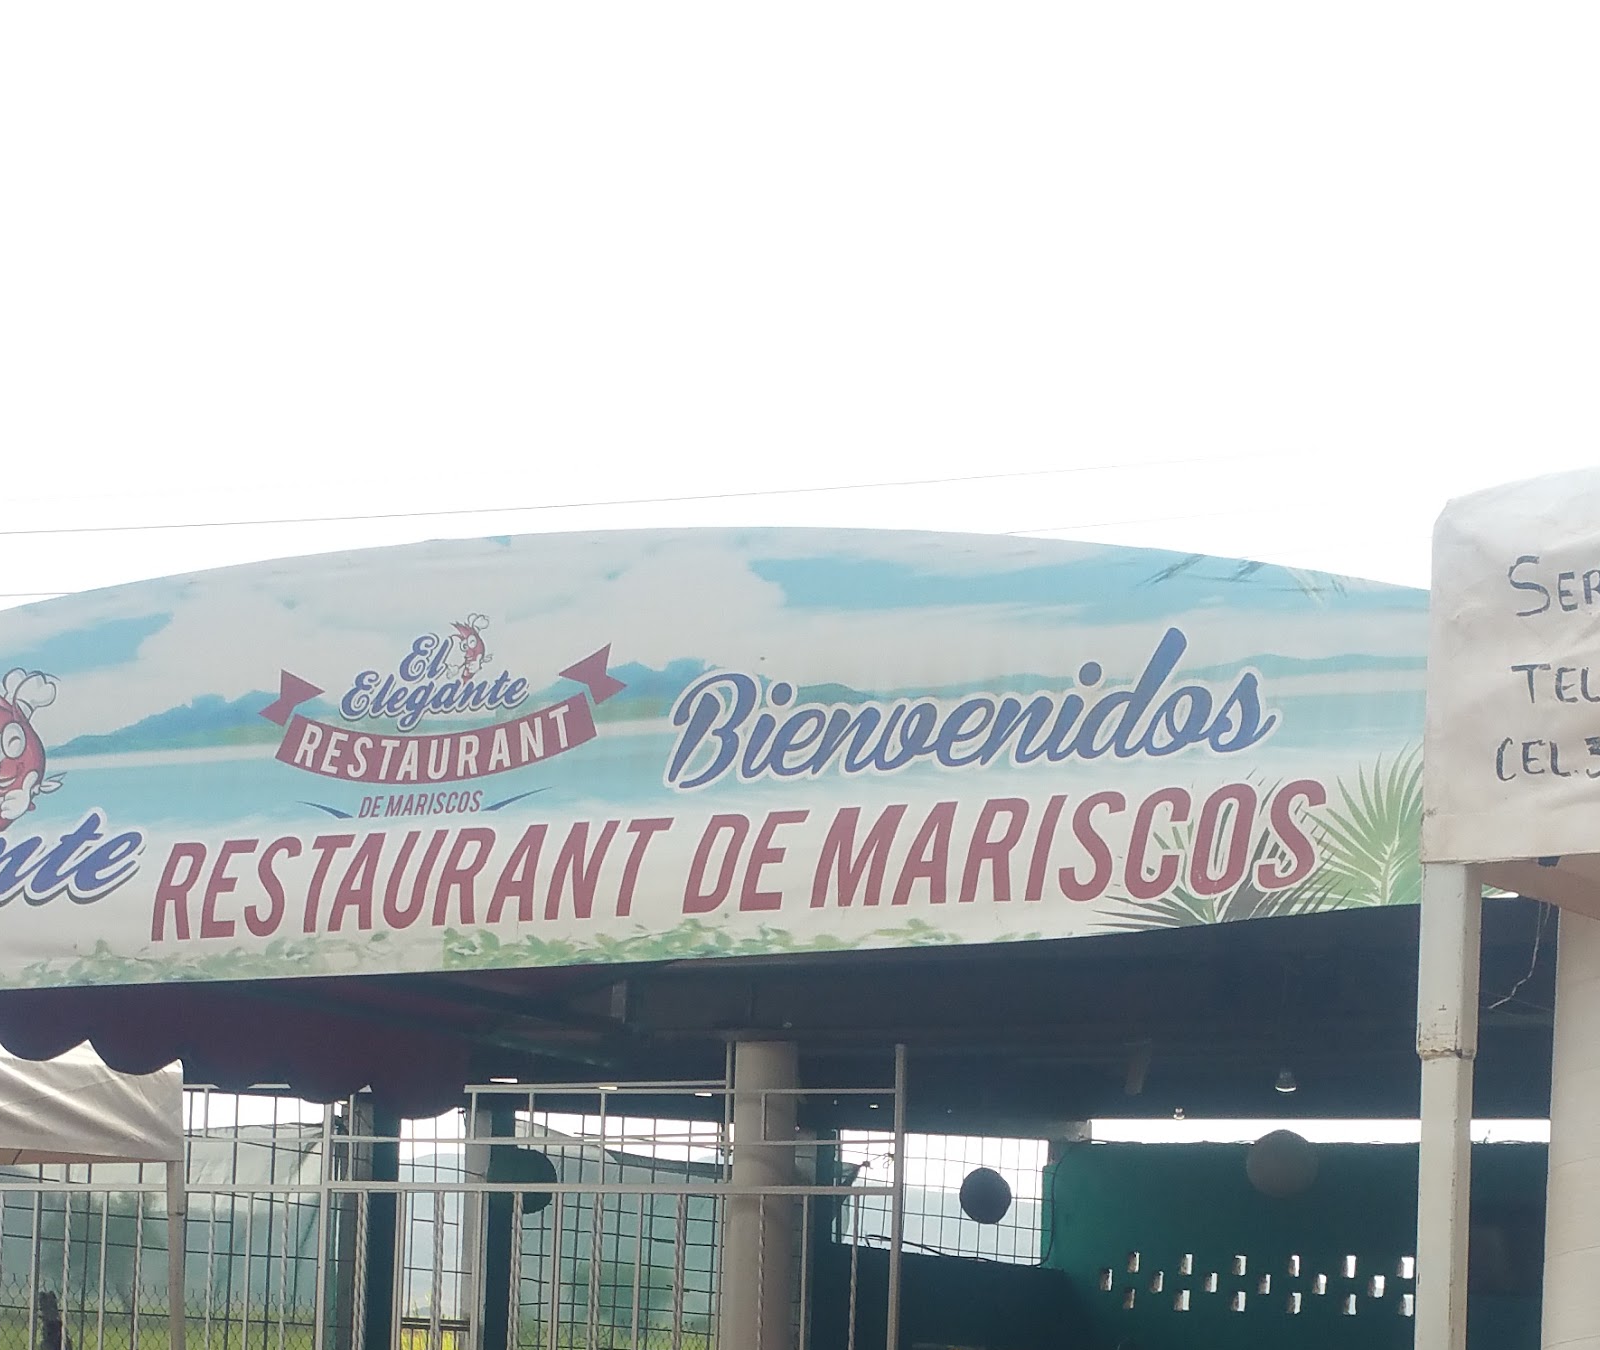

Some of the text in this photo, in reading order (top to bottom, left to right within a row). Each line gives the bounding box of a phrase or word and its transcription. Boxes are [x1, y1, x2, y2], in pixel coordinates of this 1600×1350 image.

[401, 634, 451, 683] El
[341, 668, 530, 728] Elegante
[668, 628, 1276, 788] Bienvenidos
[295, 706, 570, 781] RESTAURANT
[359, 792, 482, 817] DE MARISCOS
[151, 779, 1327, 942] RESTAURANT DE MARISCOS
